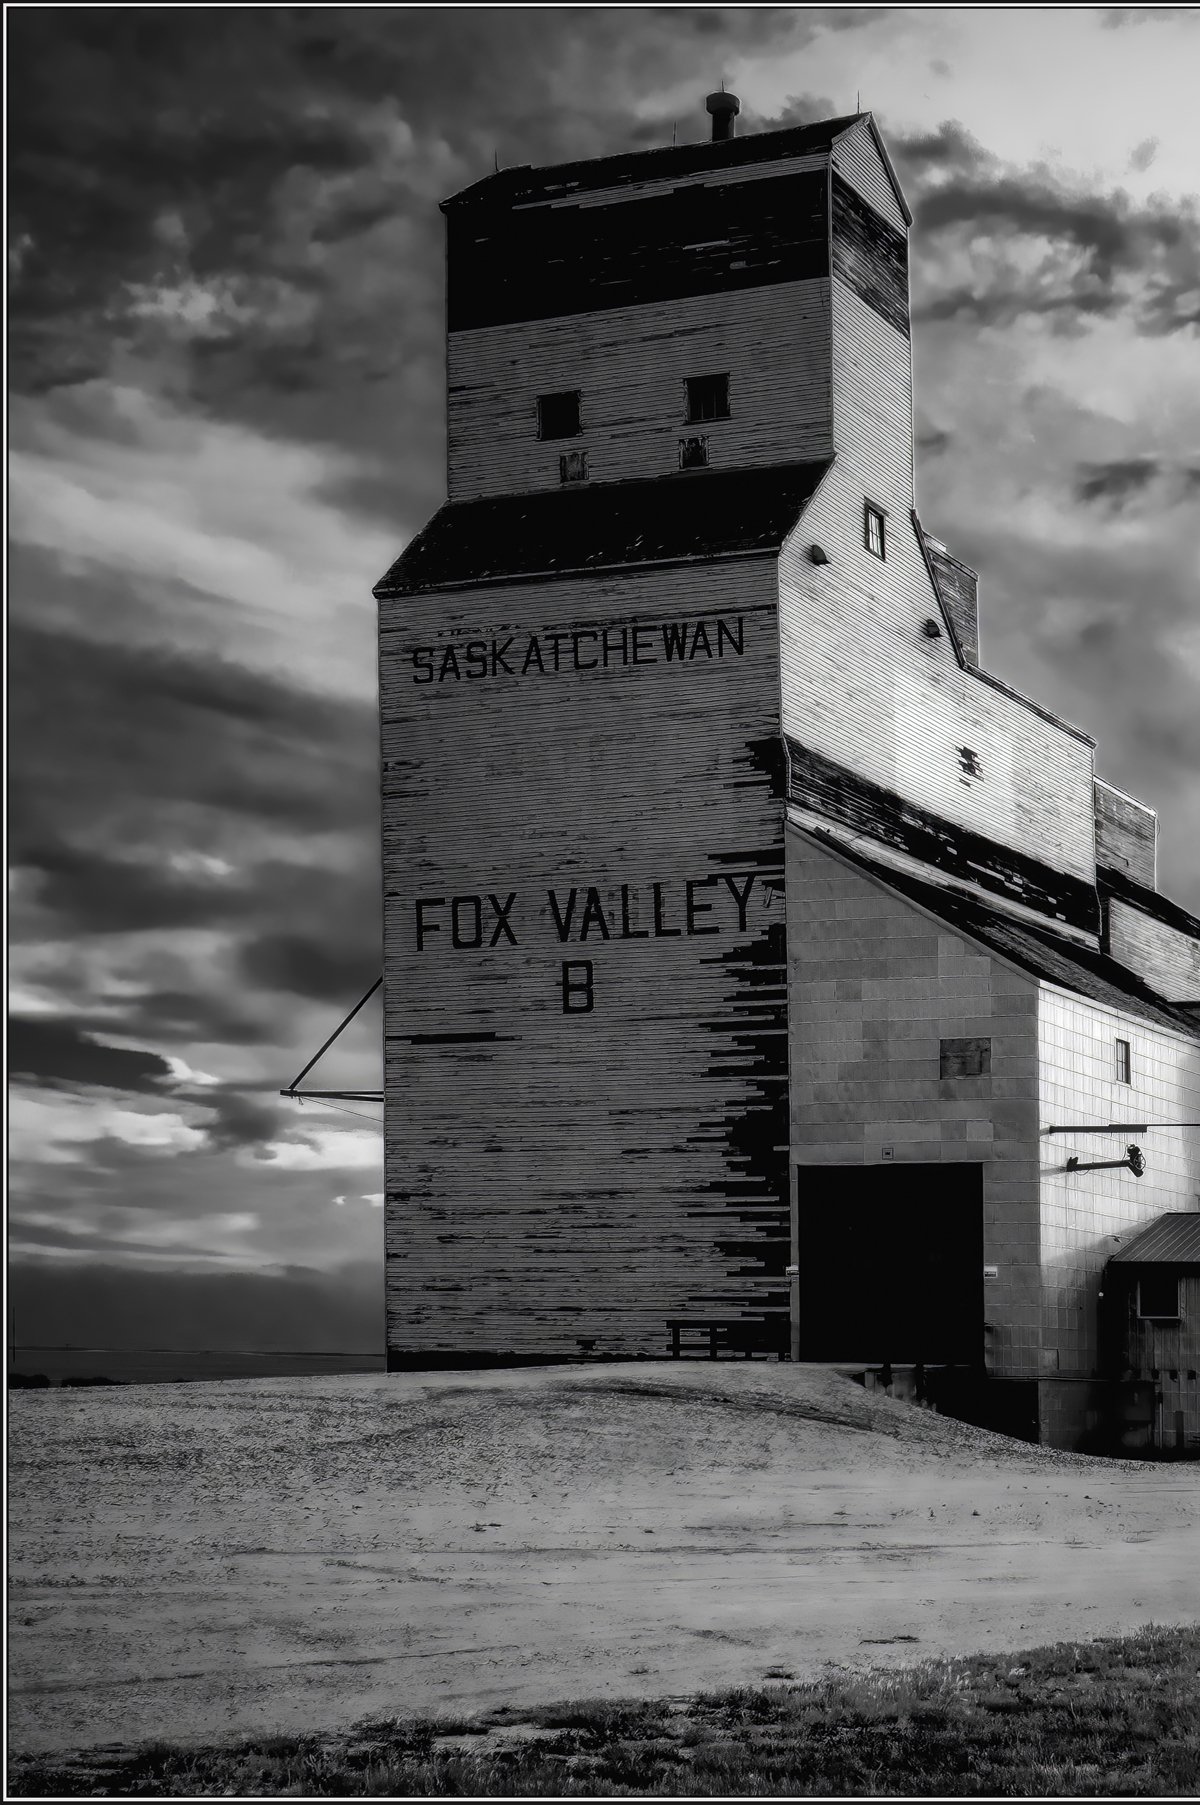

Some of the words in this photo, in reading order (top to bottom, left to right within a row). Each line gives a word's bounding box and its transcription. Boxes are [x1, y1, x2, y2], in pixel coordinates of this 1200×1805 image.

[412, 617, 744, 684] SASKATCHEWAN
[416, 892, 517, 951] FOX
[547, 875, 756, 943] VALLEY
[562, 960, 594, 1014] B
